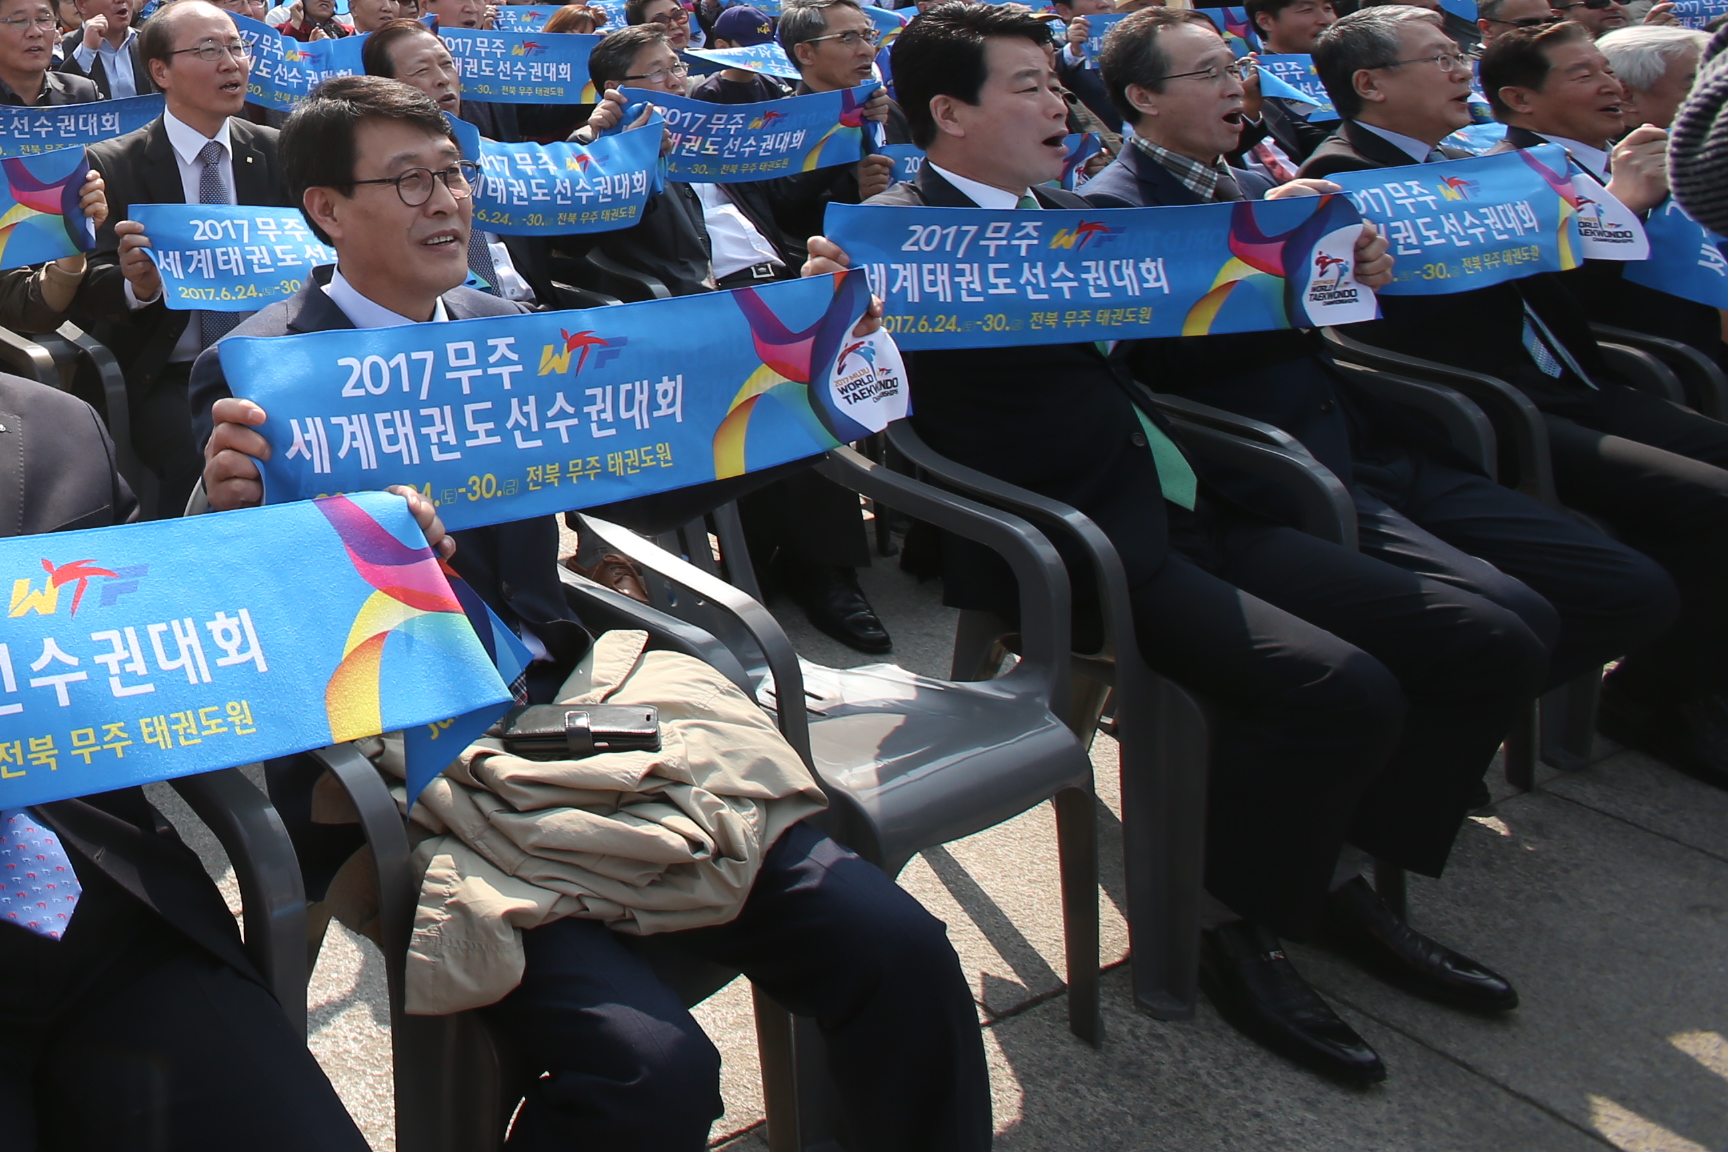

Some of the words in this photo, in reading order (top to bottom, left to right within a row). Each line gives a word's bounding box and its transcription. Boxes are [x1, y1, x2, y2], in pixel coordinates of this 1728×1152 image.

[496, 10, 518, 24] 무주
[1672, 0, 1700, 15] 2017
[260, 33, 284, 60] 무주
[476, 37, 506, 58] 무주
[501, 85, 516, 96] 전북
[707, 113, 746, 135] 무주
[20, 144, 42, 155] 전북
[514, 152, 558, 176] 무주
[720, 164, 738, 175] 전북
[741, 162, 757, 174] 무주
[759, 158, 789, 172] 태권도원
[1390, 180, 1438, 214] 무주
[557, 212, 578, 226] 전북
[580, 210, 598, 224] 무주
[601, 205, 636, 222] 태권도원
[189, 219, 250, 243] 2017
[256, 216, 309, 242] 무주
[900, 224, 978, 259] 2017
[978, 220, 1043, 258] 무주
[1462, 256, 1482, 276] 전북
[1483, 252, 1501, 270] 무주
[1502, 245, 1540, 267] 태권도원
[863, 256, 1170, 304] 세계태권도선수권대회
[1309, 289, 1358, 303] TAEKWONDO
[1029, 310, 1059, 330] 전북
[1062, 307, 1092, 327] 무주
[1095, 305, 1153, 327] 태권도원
[336, 348, 434, 400] 2017
[444, 335, 524, 383] 무주
[537, 327, 628, 378] WTF
[837, 374, 874, 395] WORLD
[842, 377, 899, 405] TAEKWONDO
[284, 372, 684, 475] 세계태권도선수권대회
[525, 463, 562, 493] 전북
[565, 453, 602, 485] 무주
[606, 441, 674, 476] 태권도원
[9, 557, 150, 619] WTF
[70, 725, 129, 766] 무주
[139, 699, 258, 752] 태권도원
